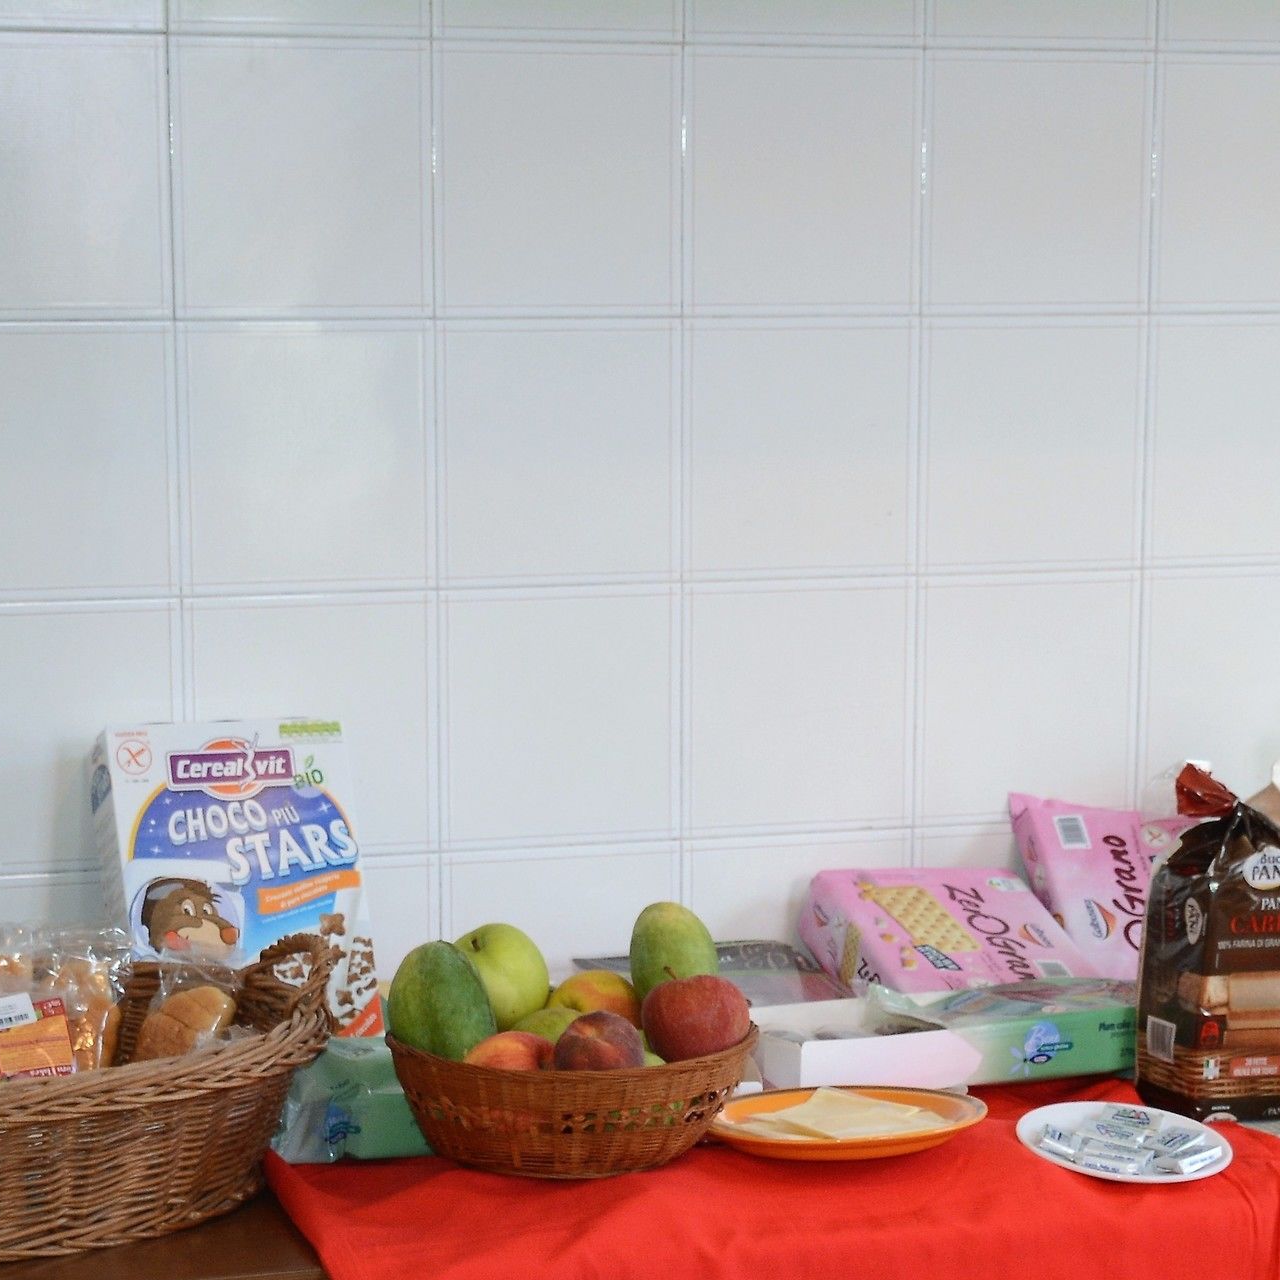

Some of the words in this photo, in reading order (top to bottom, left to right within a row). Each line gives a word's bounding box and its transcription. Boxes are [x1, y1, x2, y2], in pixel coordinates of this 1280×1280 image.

[176, 760, 243, 779] Cereal
[255, 757, 286, 775] vit
[294, 769, 324, 789] BIO
[168, 800, 268, 846] CHOCO
[225, 819, 359, 886] STARS
